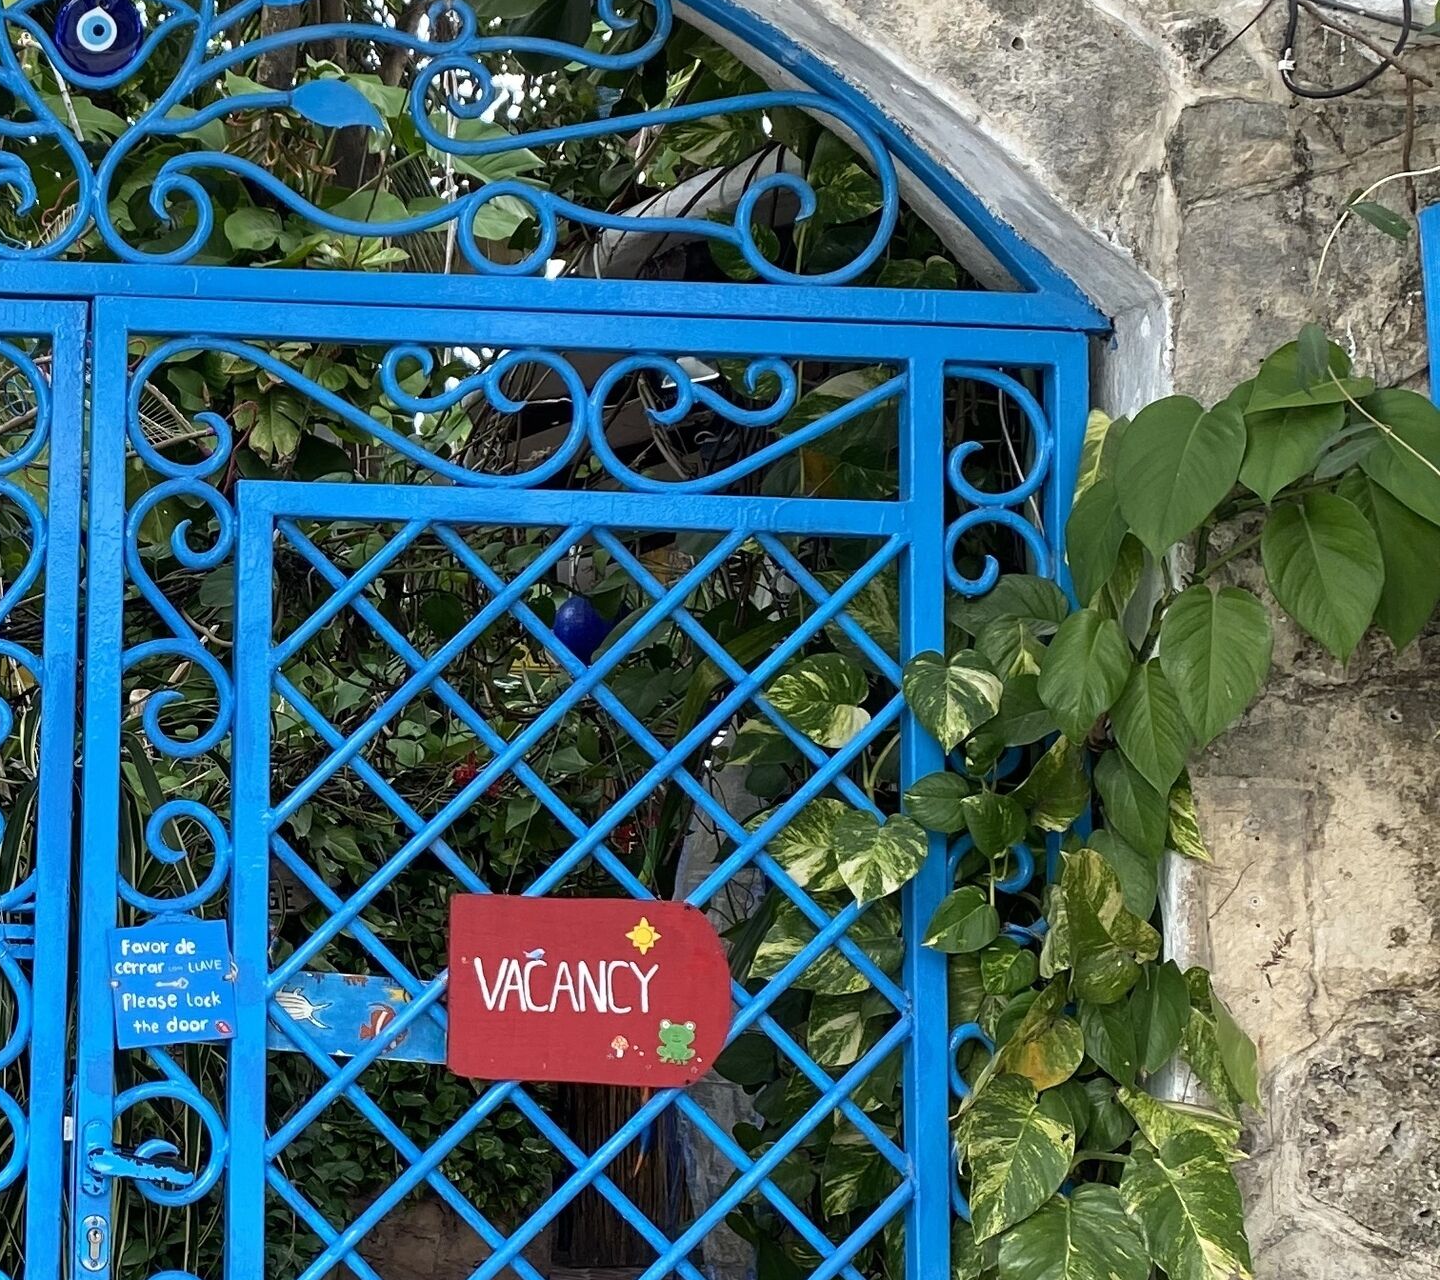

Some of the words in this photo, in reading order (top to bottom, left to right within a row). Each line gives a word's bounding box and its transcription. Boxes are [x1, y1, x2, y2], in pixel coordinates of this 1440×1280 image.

[121, 938, 169, 956] Favor
[175, 938, 196, 955] de
[114, 961, 165, 976] cerrar
[474, 956, 658, 1014] VACANCY
[122, 992, 178, 1012] Please
[186, 991, 222, 1008] lock
[133, 1019, 159, 1034] the
[166, 1016, 209, 1034] door
